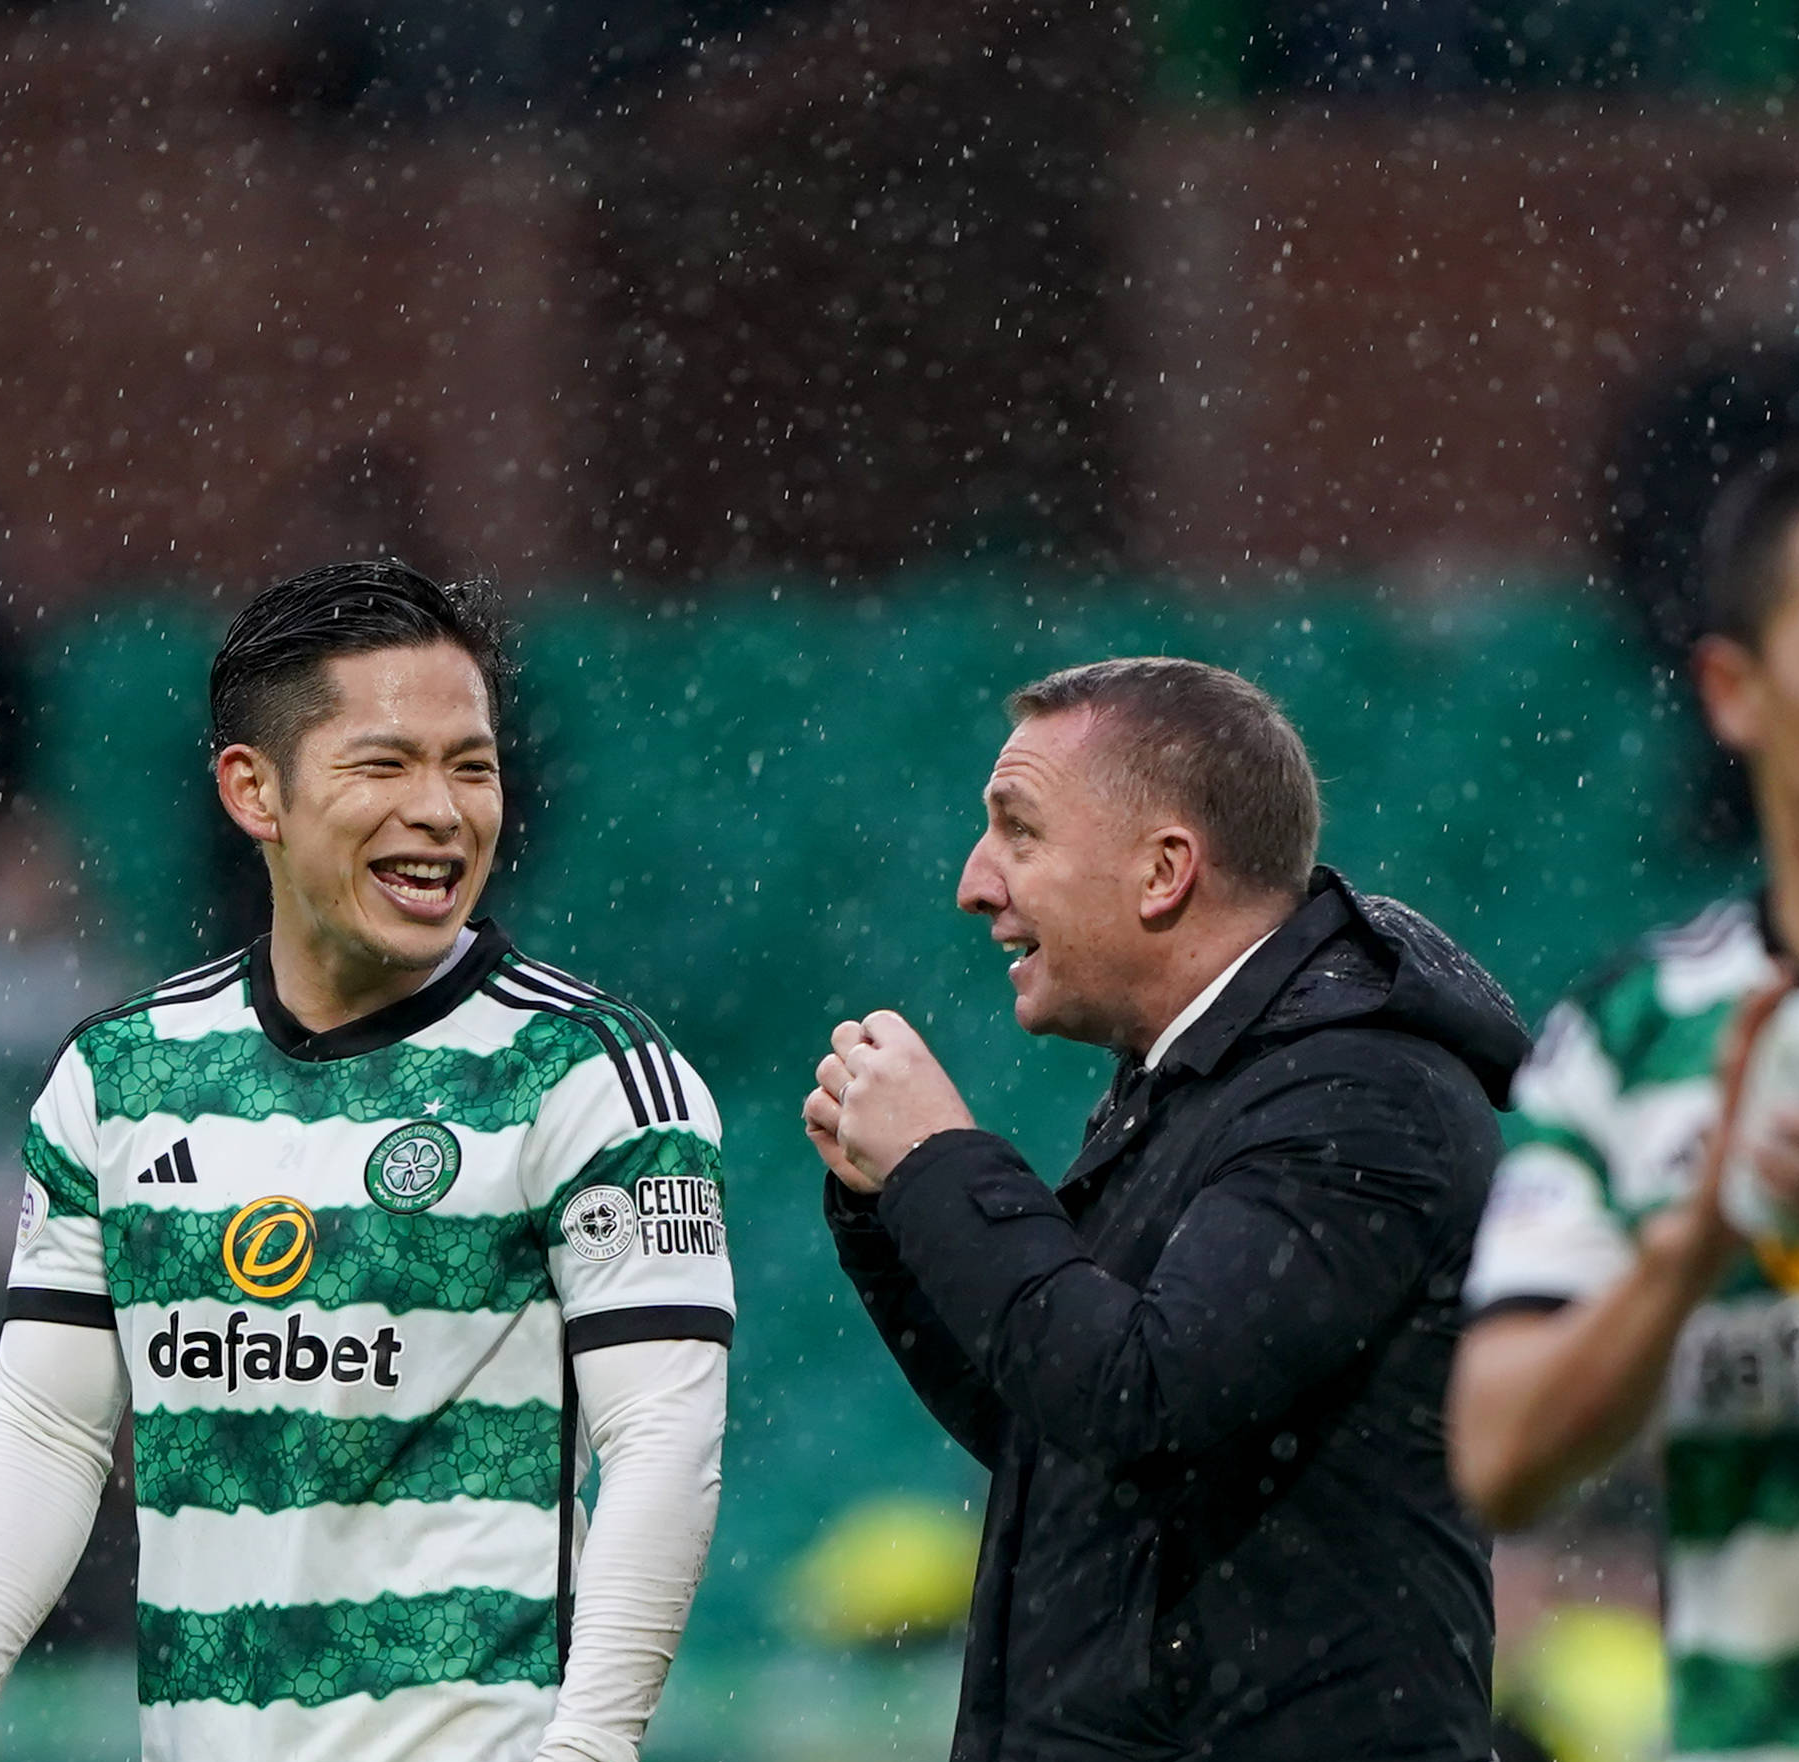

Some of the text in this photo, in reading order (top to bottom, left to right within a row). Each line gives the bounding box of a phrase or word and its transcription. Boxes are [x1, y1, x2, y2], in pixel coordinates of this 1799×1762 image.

[384, 1127, 414, 1150] CELTIC
[414, 1126, 452, 1148] FOOTBALL
[444, 1148, 455, 1171] CLUB
[638, 1179, 709, 1216] CELTIC
[639, 1219, 726, 1257] FOUND
[148, 1309, 402, 1393] dafabet
